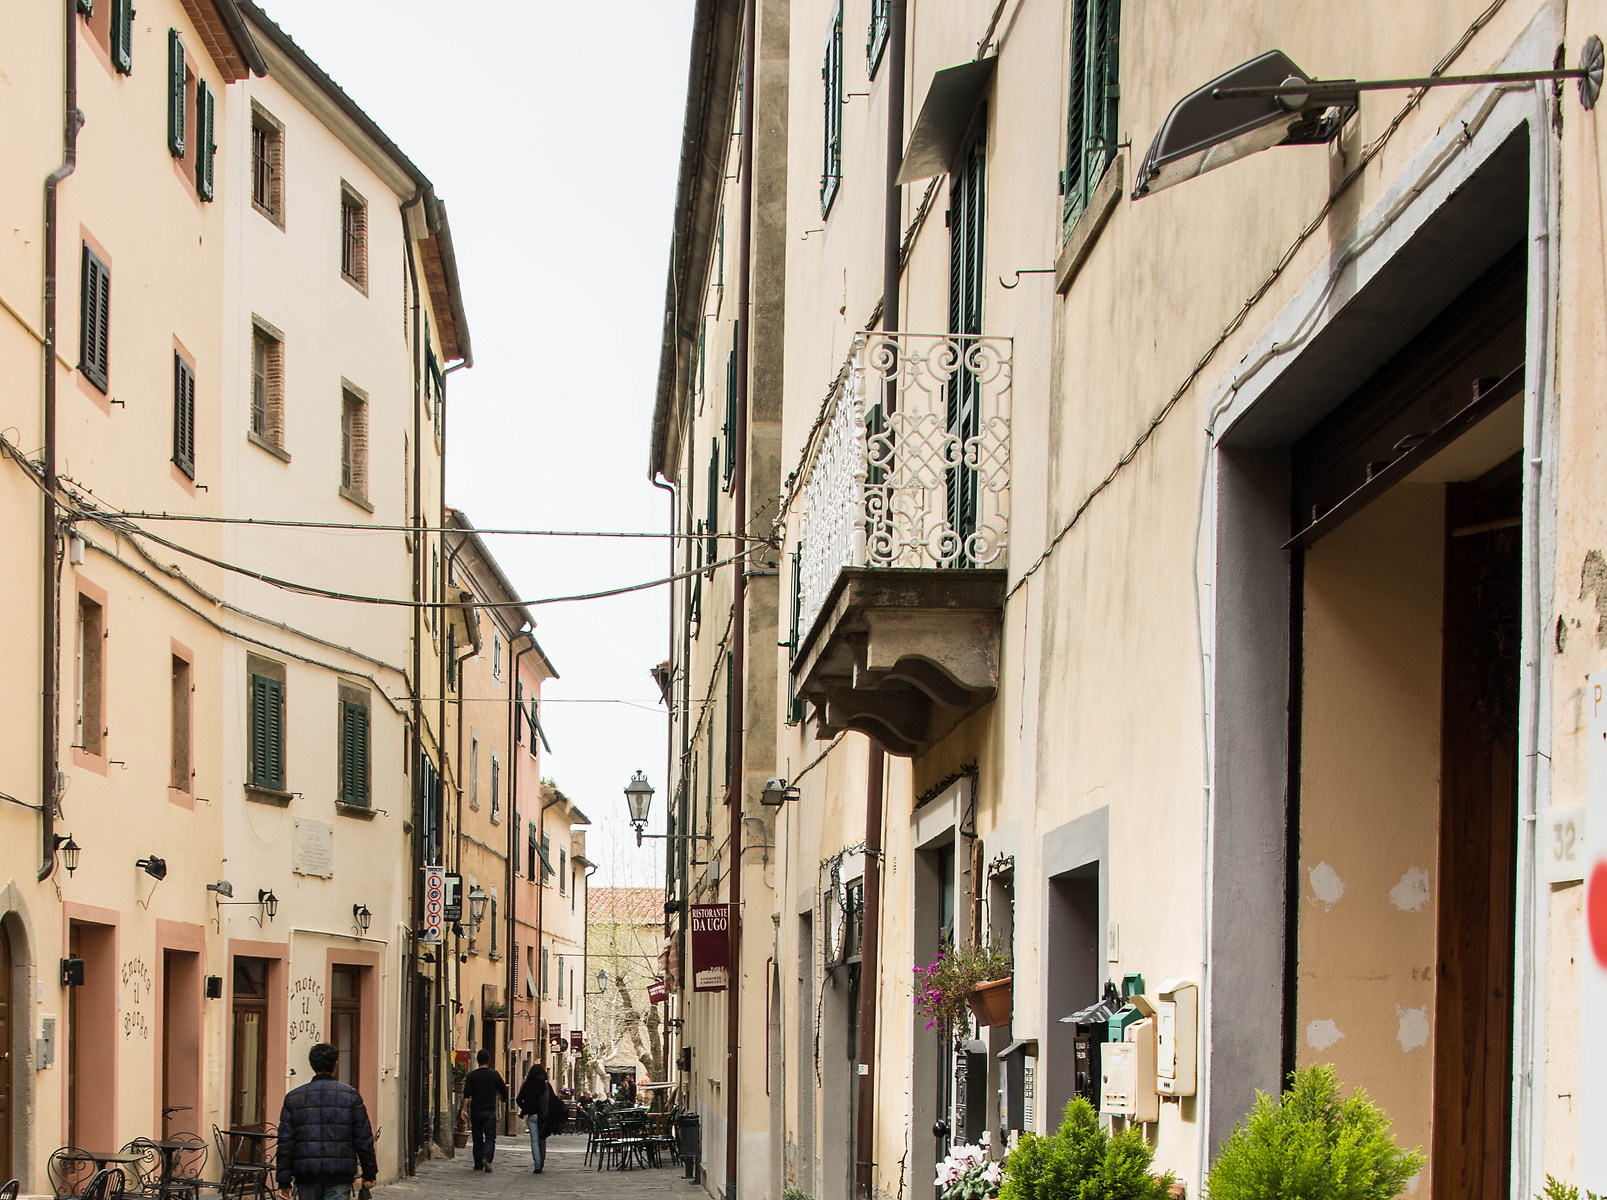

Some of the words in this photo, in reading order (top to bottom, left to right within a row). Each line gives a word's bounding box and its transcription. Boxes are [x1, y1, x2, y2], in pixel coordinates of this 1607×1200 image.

[1594, 684, 1602, 718] P
[1553, 821, 1577, 863] 32
[428, 877, 440, 937] LOTTO
[692, 908, 727, 918] RISTORANTE
[693, 918, 706, 931] DA
[707, 918, 727, 931] UGO
[121, 954, 151, 995] Enoteca
[133, 982, 139, 1004] il
[302, 996, 309, 1014] il
[124, 1012, 148, 1041] Borgo
[290, 1020, 320, 1044] Borgo
